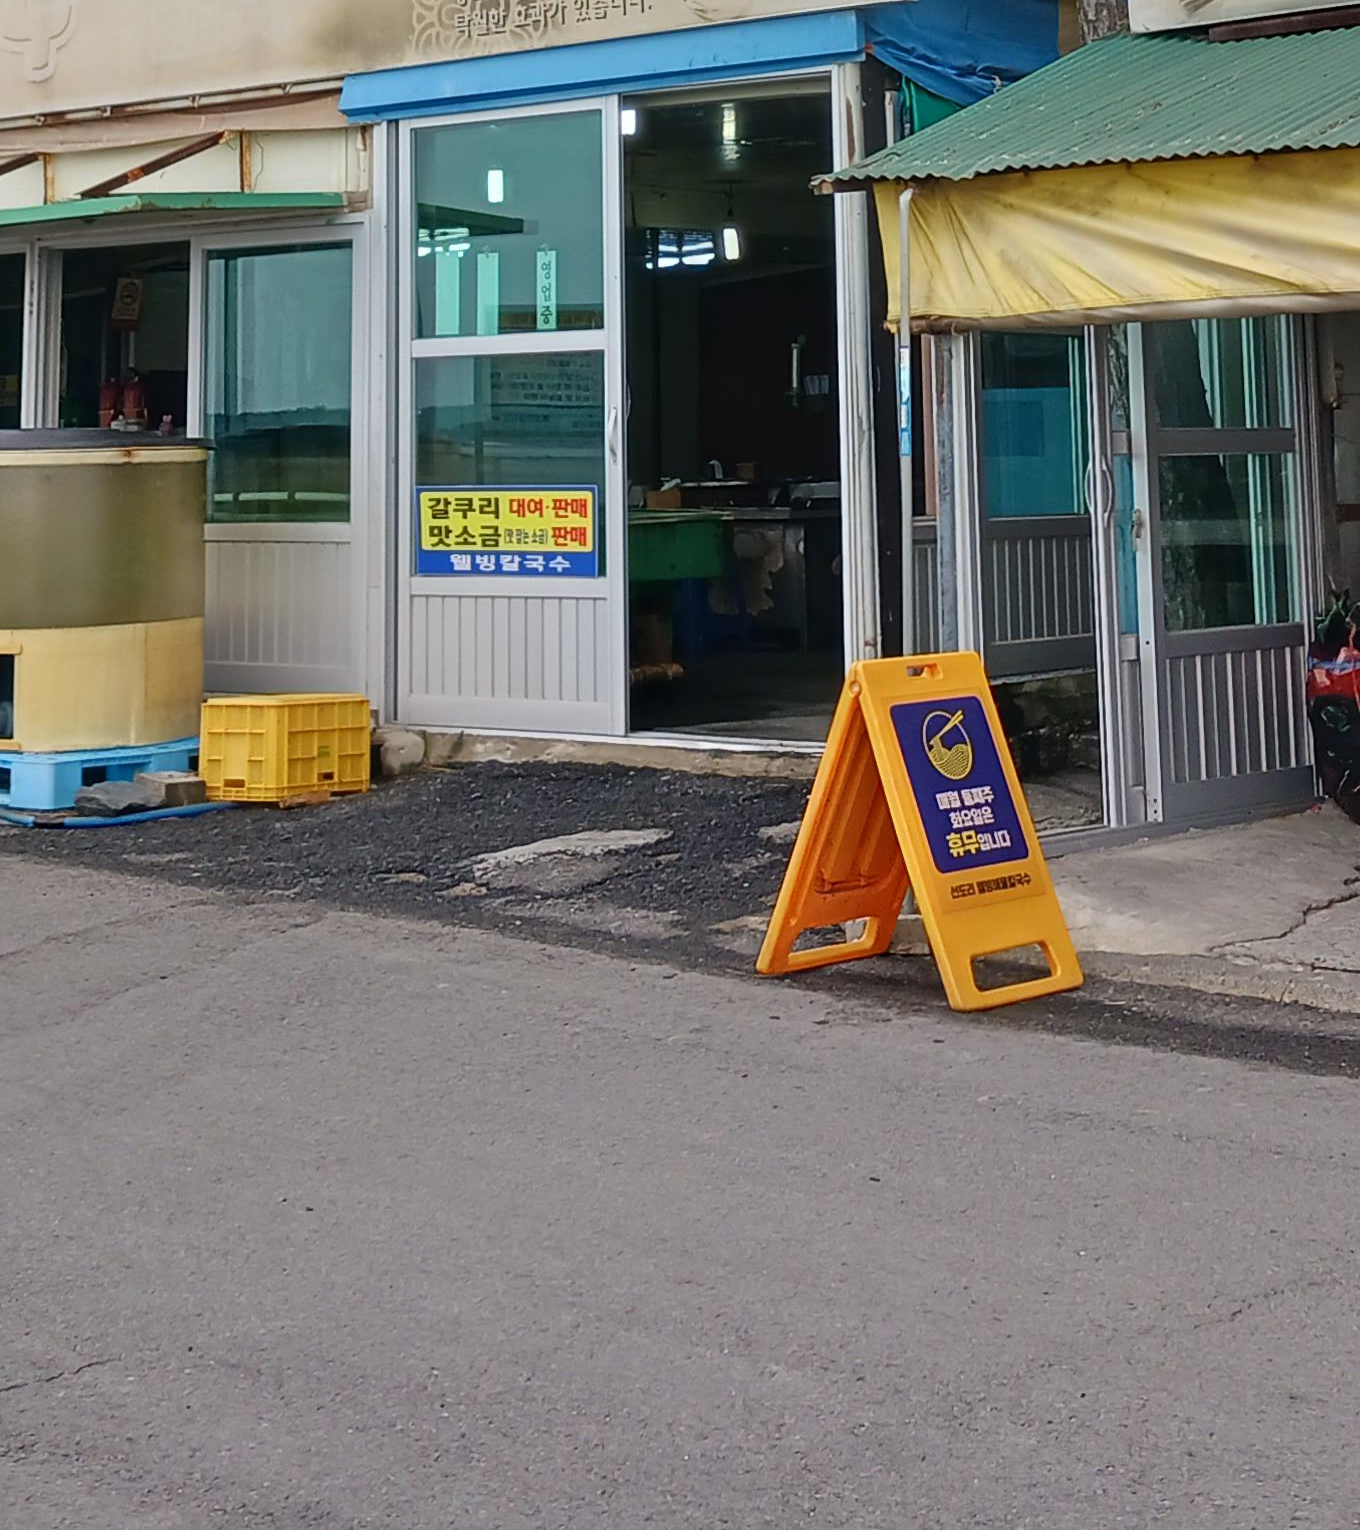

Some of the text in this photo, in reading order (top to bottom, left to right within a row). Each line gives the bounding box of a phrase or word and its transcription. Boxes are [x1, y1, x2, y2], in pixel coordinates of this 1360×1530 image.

[427, 497, 500, 520] 갈쿠리
[428, 525, 501, 548] 맛소금
[551, 526, 588, 547] 판매
[449, 553, 571, 573] 웰빙칼국수
[950, 807, 994, 828] 화요일은
[946, 830, 1011, 857] 휴무입니다
